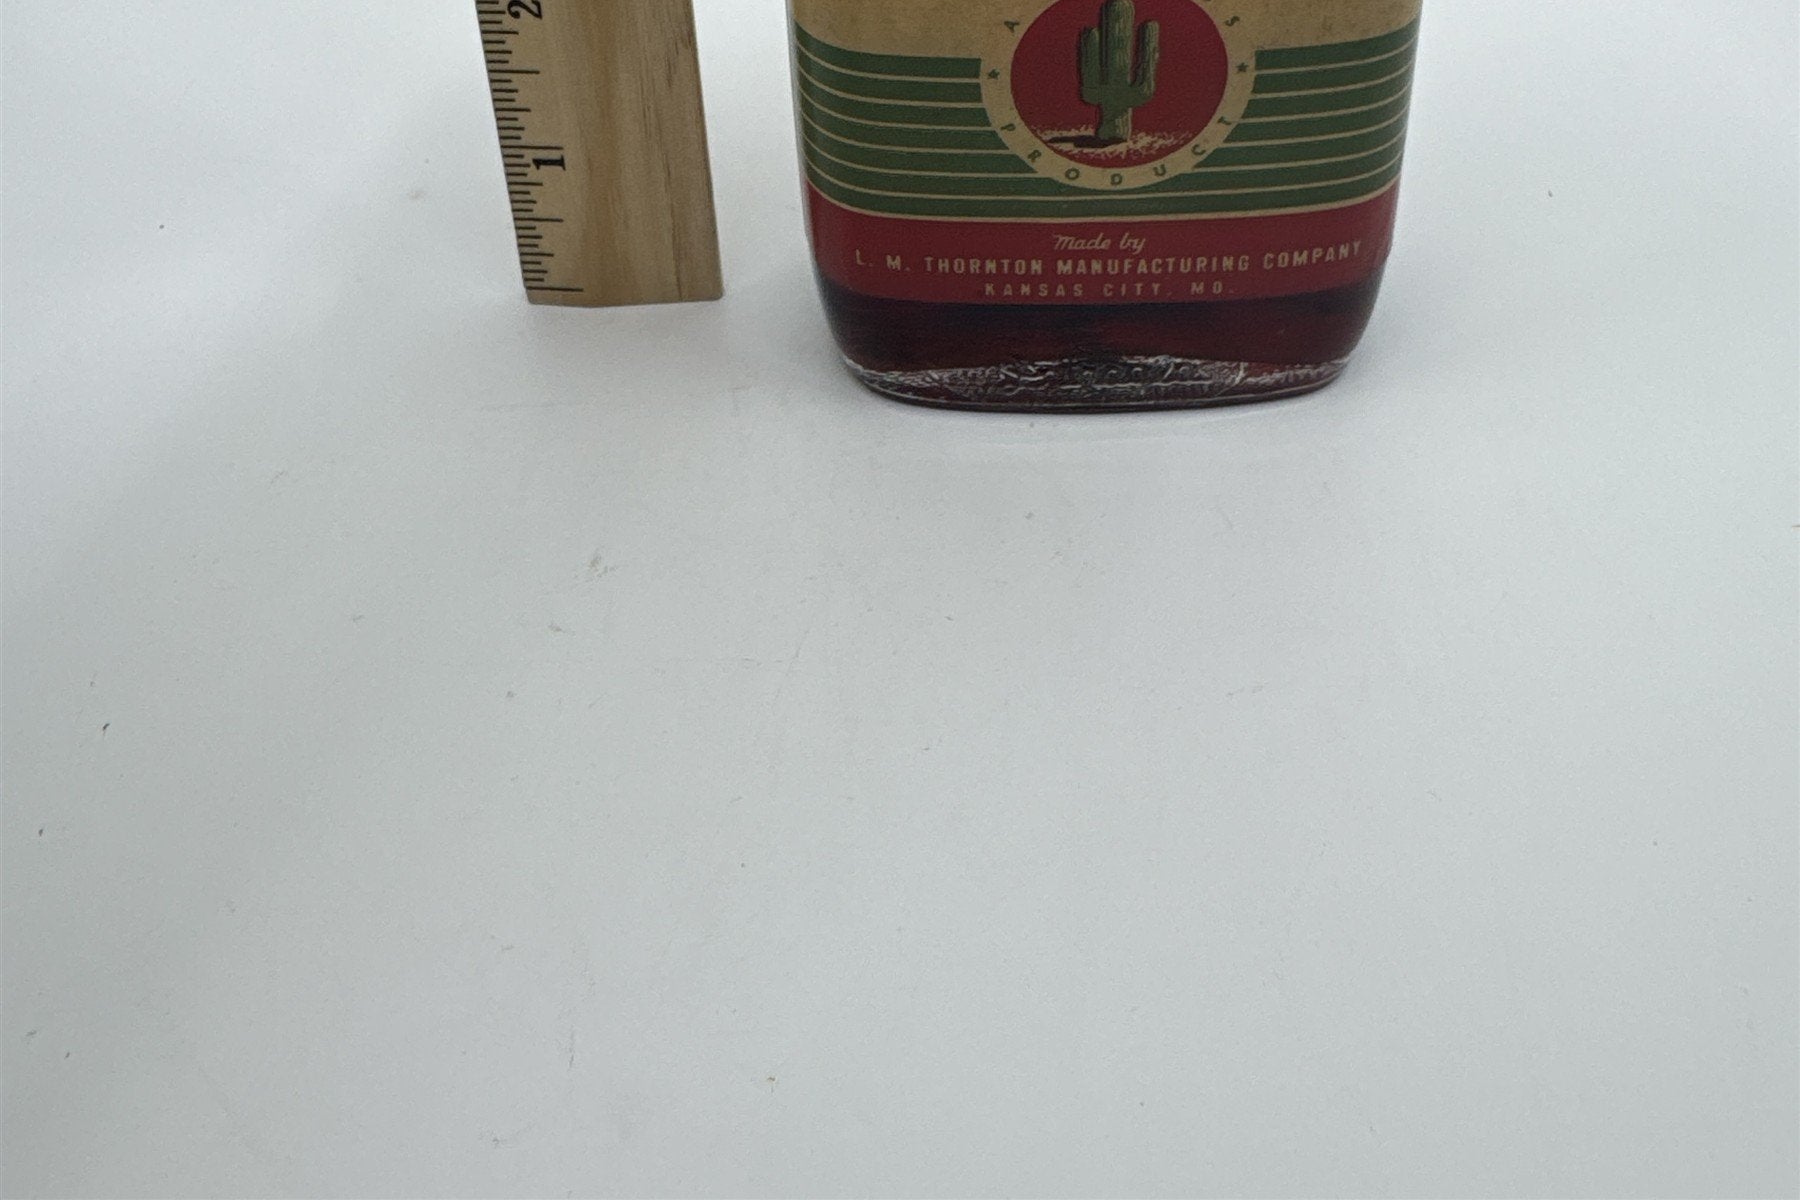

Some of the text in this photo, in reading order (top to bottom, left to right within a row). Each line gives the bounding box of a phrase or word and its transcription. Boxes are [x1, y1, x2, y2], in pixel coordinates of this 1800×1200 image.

[507, 0, 543, 20] 2
[1000, 116, 1233, 186] PRODUCT
[532, 154, 566, 171] 1
[1053, 232, 1146, 255] Made by
[886, 255, 911, 272] M.
[924, 256, 1043, 275] THORNTON
[1056, 255, 1250, 275] MANUFACTURING
[1263, 240, 1362, 269] COMPANY
[985, 282, 1084, 297] KANSAS
